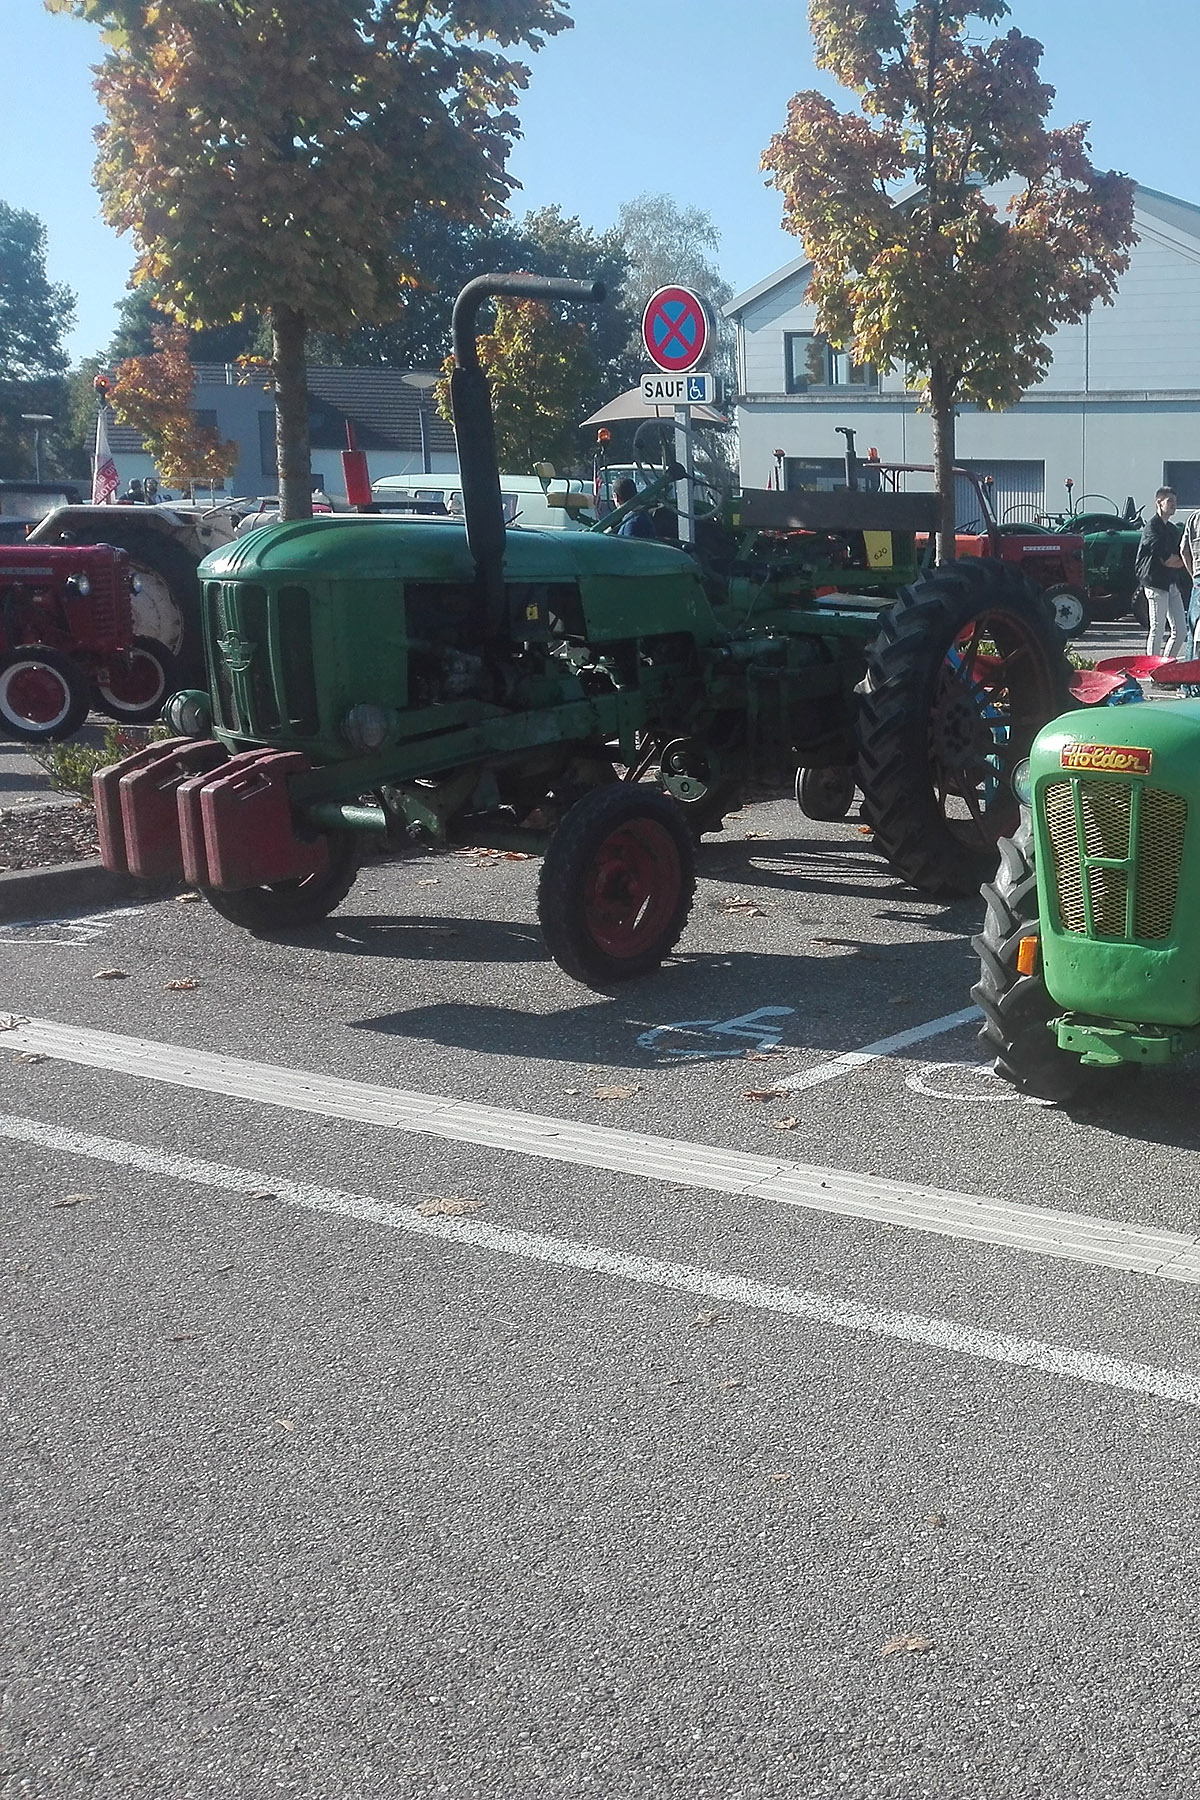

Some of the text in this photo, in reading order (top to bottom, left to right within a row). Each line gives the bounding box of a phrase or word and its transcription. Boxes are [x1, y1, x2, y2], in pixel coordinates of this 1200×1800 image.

[644, 381, 684, 398] SAUF
[874, 547, 888, 560] 620
[1064, 744, 1147, 770] Holder
